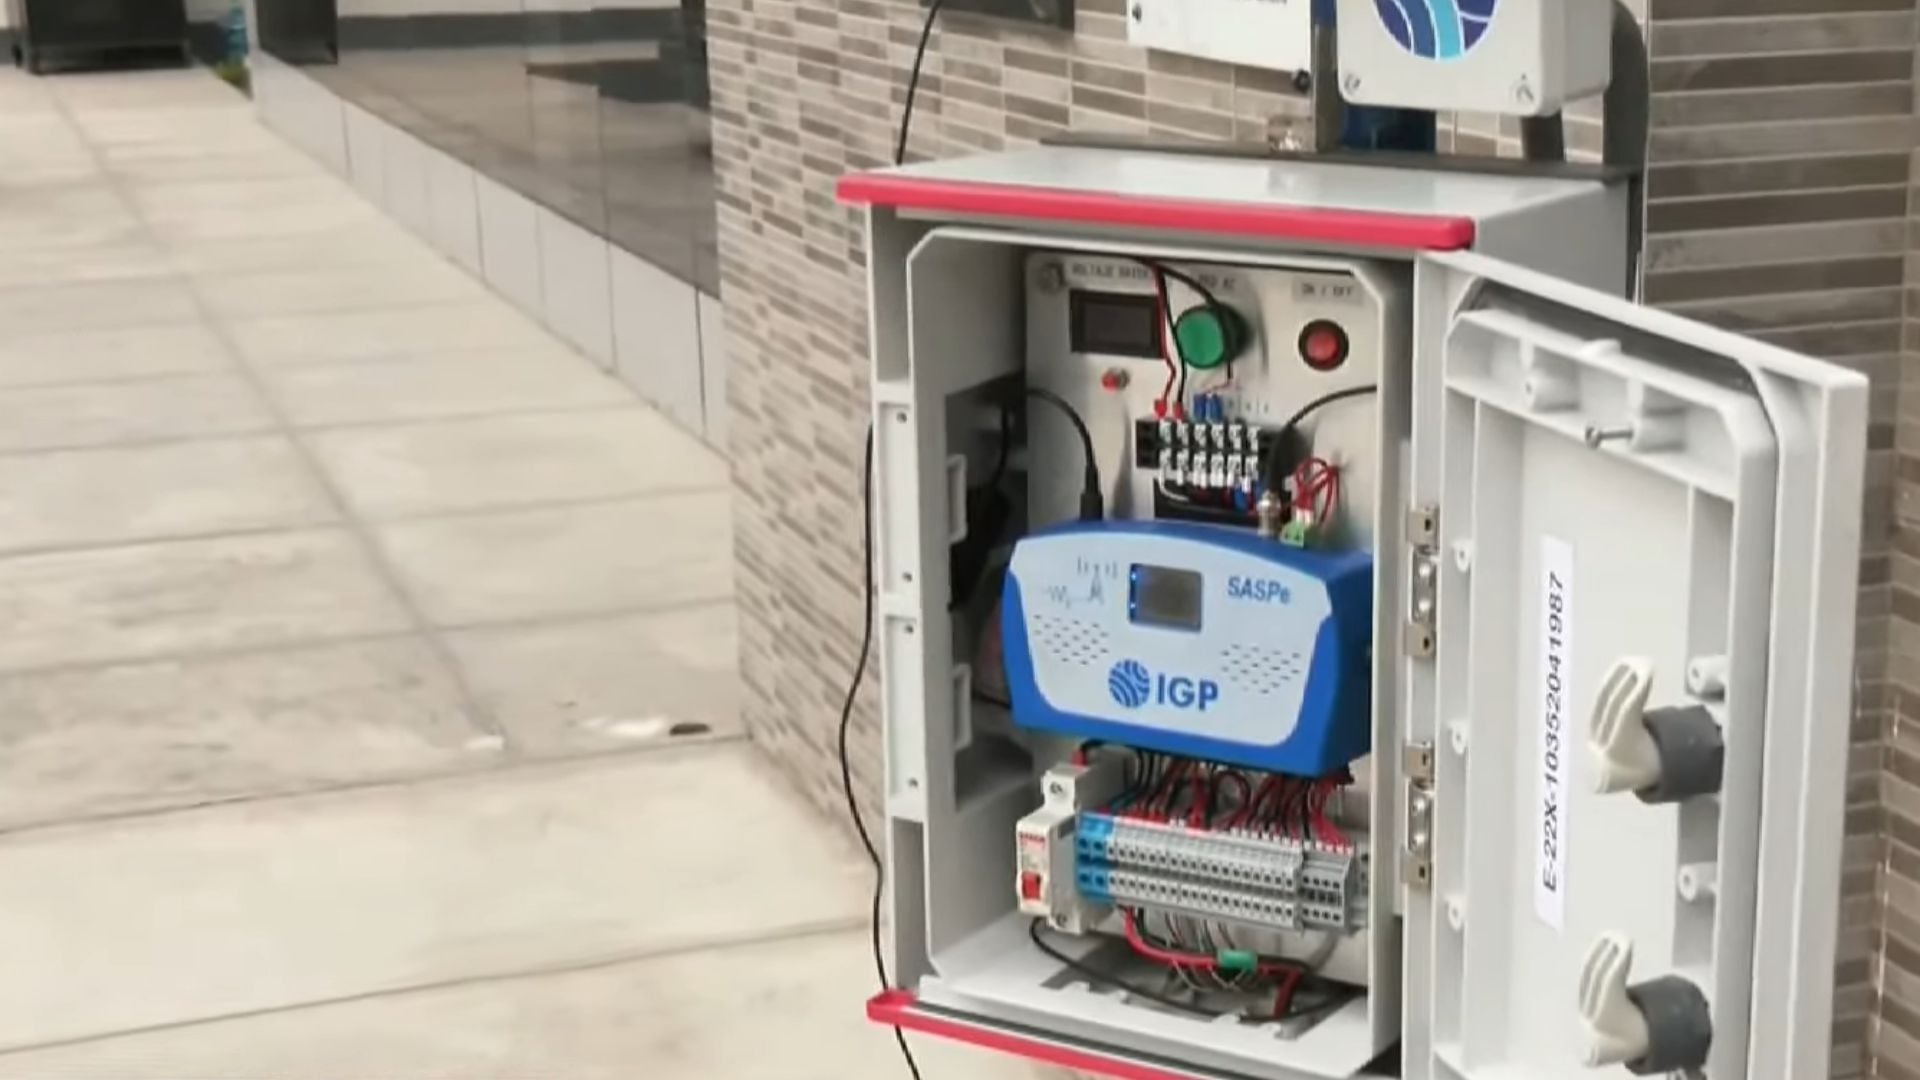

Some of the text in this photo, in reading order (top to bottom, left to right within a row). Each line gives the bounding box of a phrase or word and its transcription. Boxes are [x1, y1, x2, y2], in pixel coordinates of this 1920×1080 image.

[1227, 576, 1291, 604] SASPe
[1156, 676, 1219, 711] IGP
[1542, 571, 1564, 892] E-22X-10352041987
